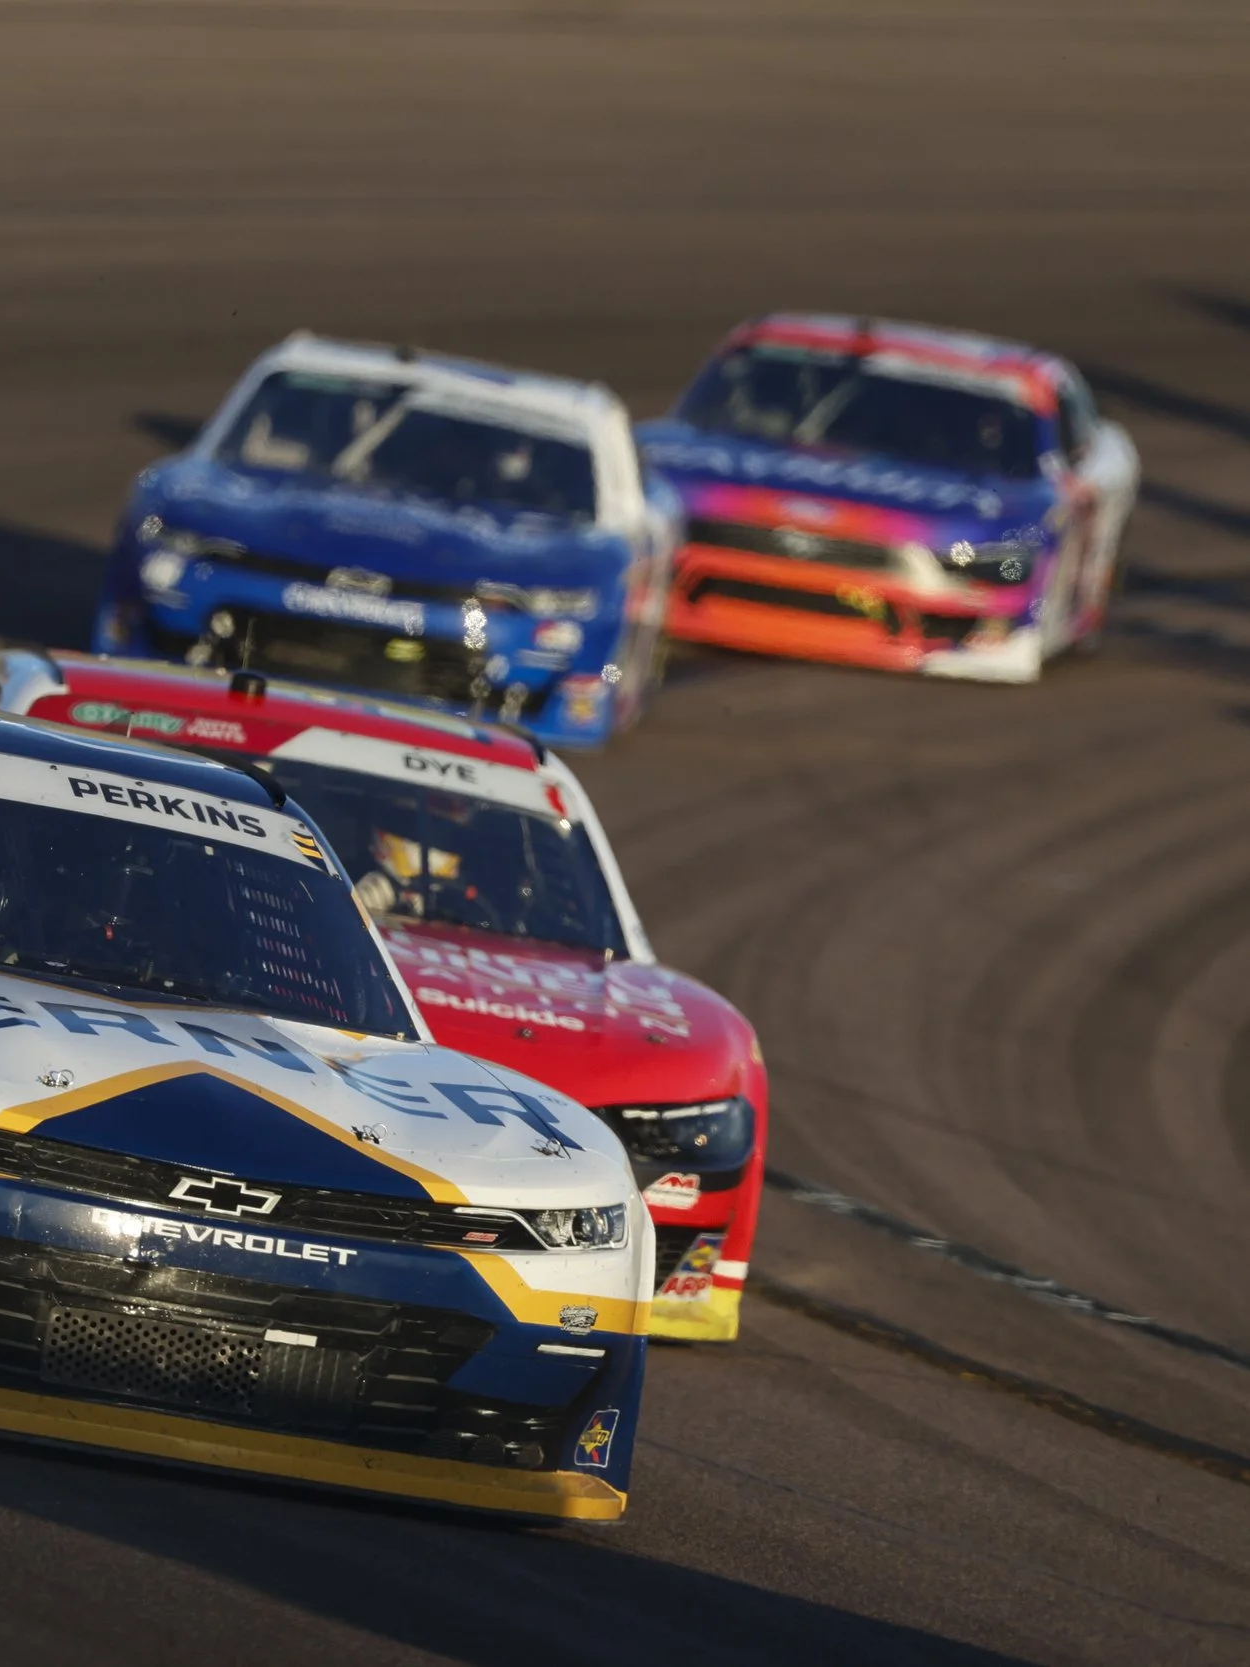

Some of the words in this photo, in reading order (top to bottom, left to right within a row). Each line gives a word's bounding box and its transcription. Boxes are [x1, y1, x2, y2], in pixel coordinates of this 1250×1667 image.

[404, 755, 479, 786] DYE
[67, 775, 268, 839] PERKINS
[415, 986, 586, 1032] Suicide
